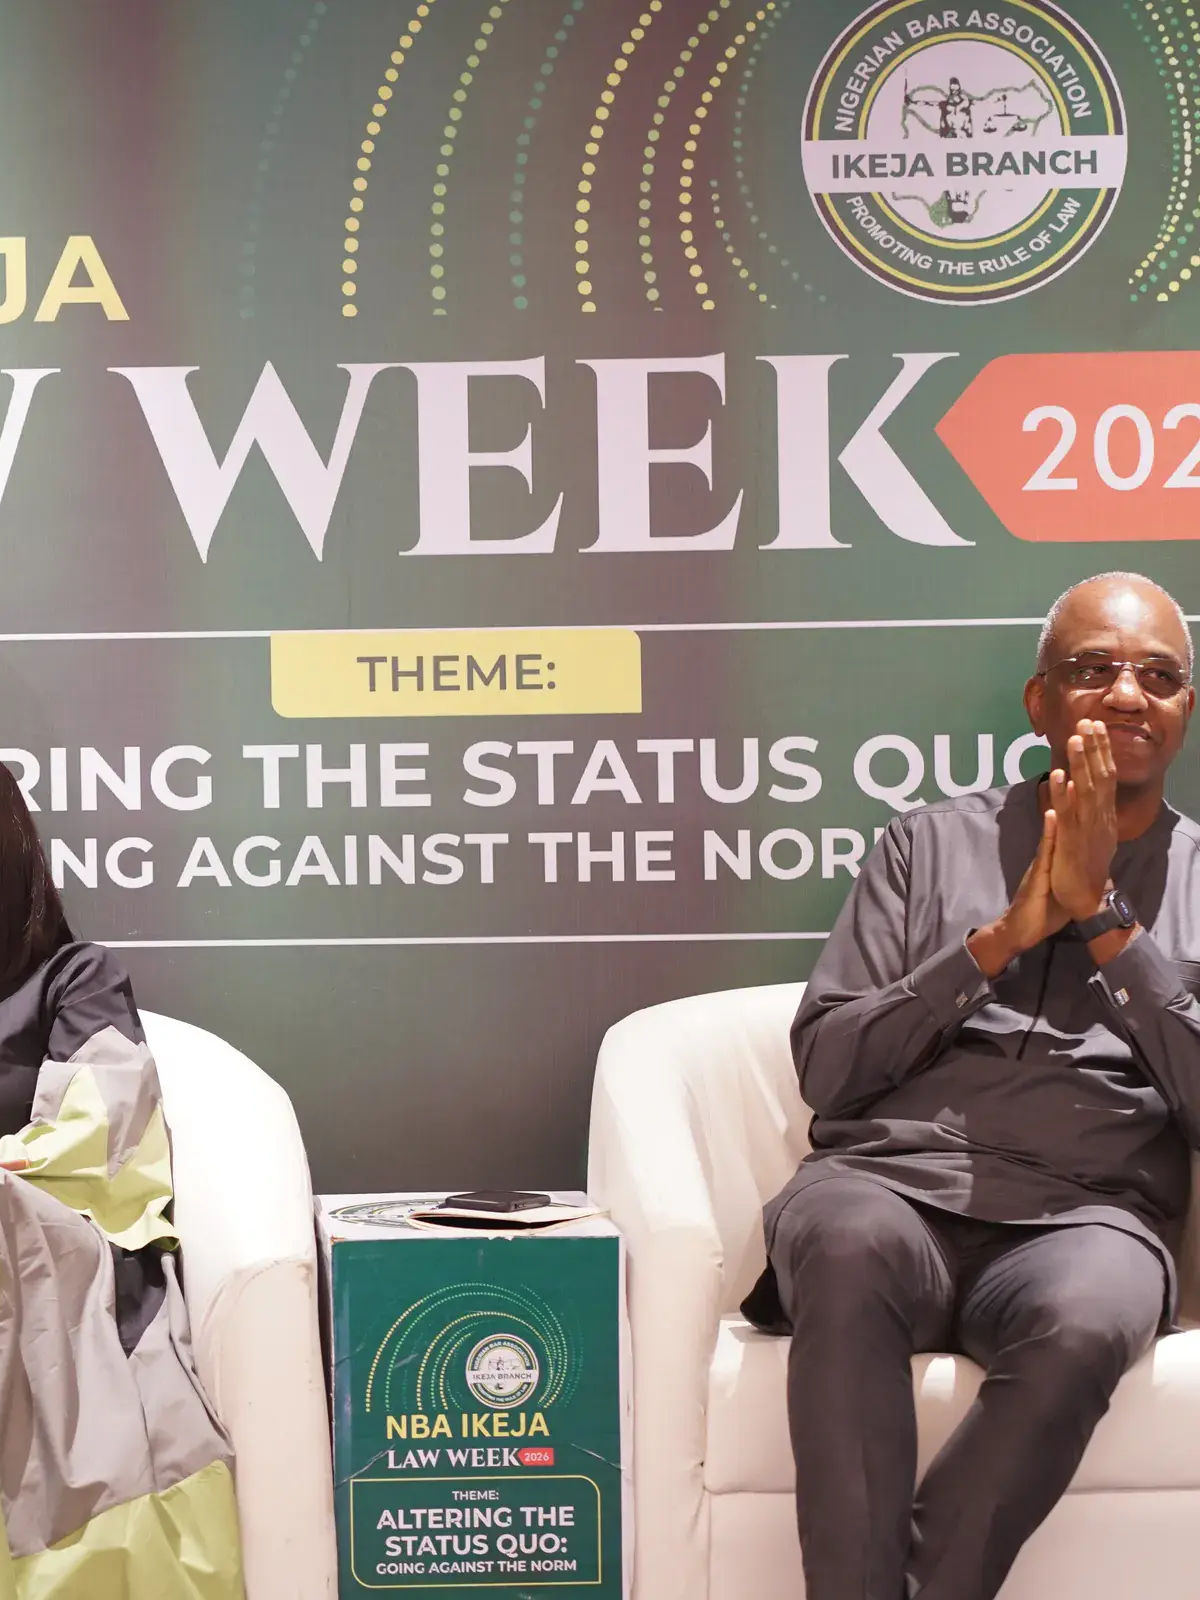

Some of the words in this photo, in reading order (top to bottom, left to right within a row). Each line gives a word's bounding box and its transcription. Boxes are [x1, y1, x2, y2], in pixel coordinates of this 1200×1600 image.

[835, 31, 904, 131] NIGERIAN
[906, 10, 959, 39] BAR
[966, 10, 1091, 118] ASSOCIATION
[832, 153, 934, 179] IKEJA
[946, 150, 1098, 176] BRANCH
[846, 196, 932, 269] PROMOTING
[937, 260, 975, 275] THE
[979, 247, 1031, 273] RULE
[1029, 230, 1053, 251] OF
[1049, 197, 1081, 233] LAW
[107, 352, 977, 564] WEEK
[357, 654, 556, 692] THEME:
[243, 742, 432, 808] THE
[462, 735, 823, 807] STATUS
[177, 832, 509, 888] AGAINST
[528, 830, 675, 883] THE
[702, 824, 885, 880] NOR
[386, 1413, 453, 1440] NBA
[462, 1412, 550, 1437] IKEJA
[388, 1449, 441, 1468] LAW
[446, 1447, 521, 1467] WEEK
[524, 1452, 549, 1462] 2026
[452, 1490, 499, 1501] THEME:
[376, 1507, 512, 1530] ALTERING
[520, 1506, 575, 1527] THE
[385, 1534, 489, 1557] STATUS
[496, 1533, 568, 1558] QUO:
[376, 1562, 425, 1575] GOING
[428, 1561, 494, 1574] AGAINST
[498, 1560, 526, 1572] THE
[531, 1559, 577, 1572] NORM
